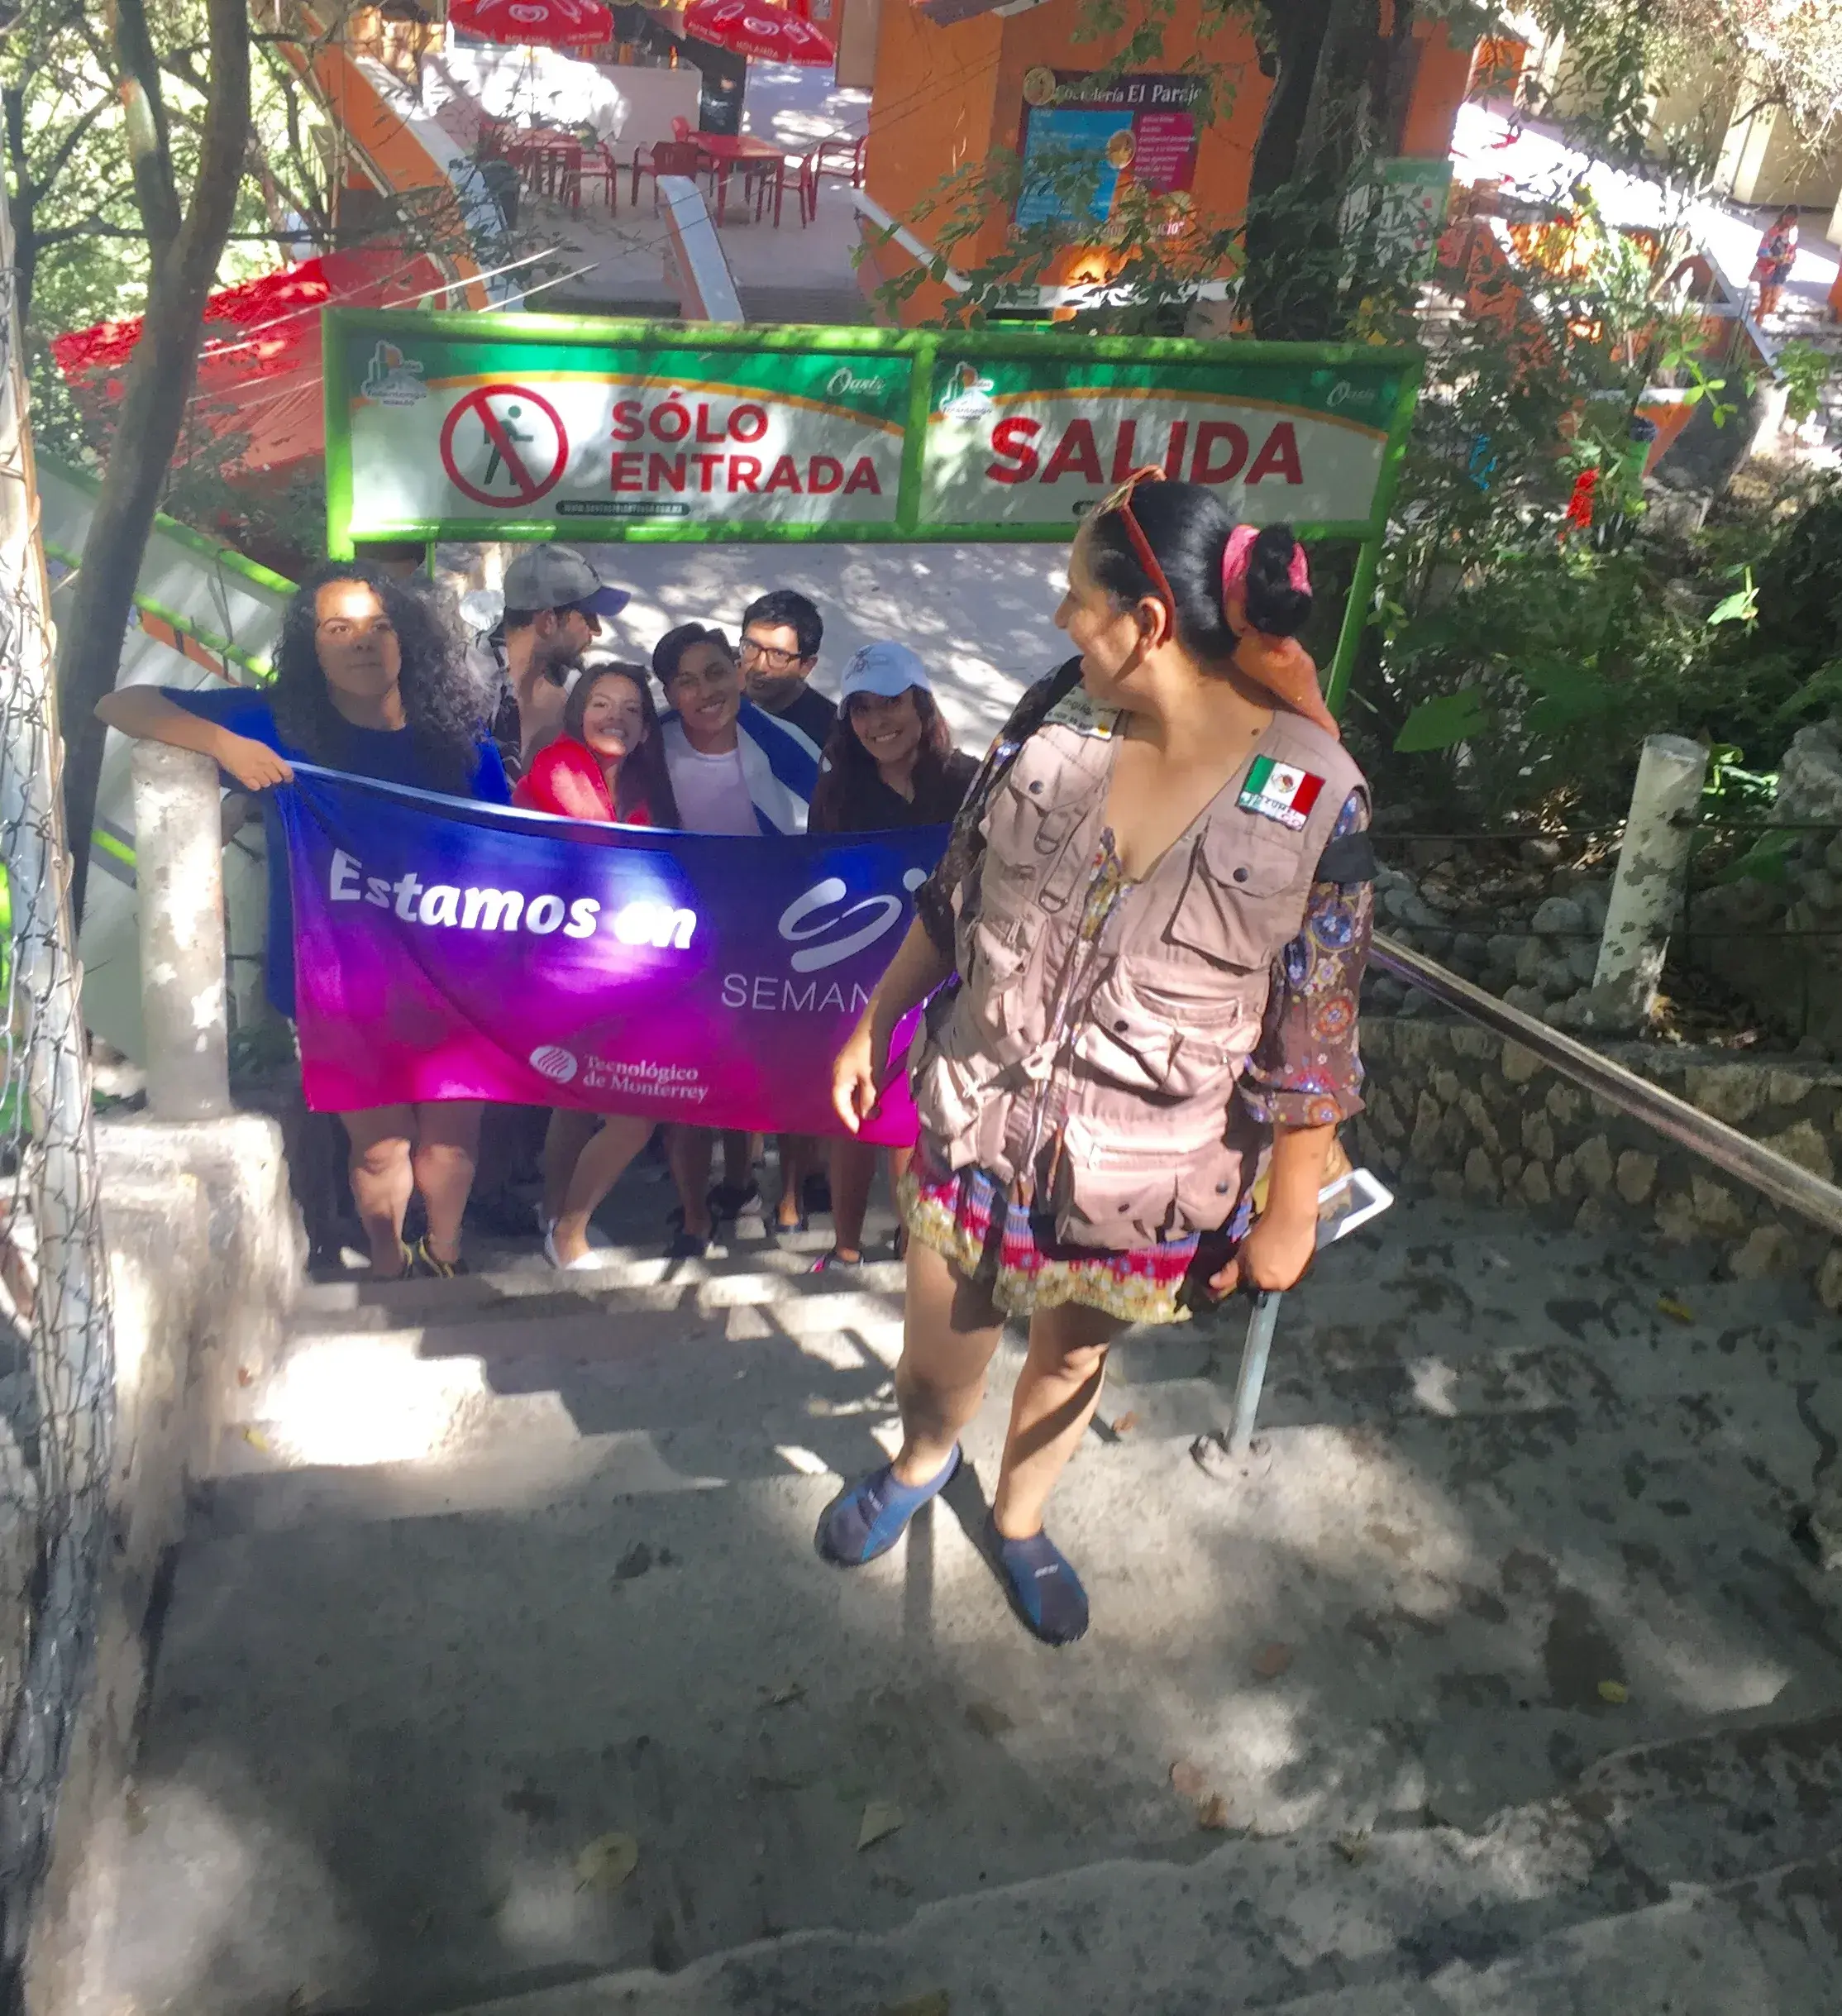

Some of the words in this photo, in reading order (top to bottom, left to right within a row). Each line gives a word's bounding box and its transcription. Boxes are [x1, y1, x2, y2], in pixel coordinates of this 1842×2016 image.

[736, 41, 780, 60] HOLANDA
[1127, 84, 1145, 103] El
[610, 390, 769, 444] SÓLO
[985, 416, 1304, 485] SALIDA
[610, 451, 882, 495] ENTRADA
[330, 848, 601, 939] Estamos
[614, 901, 698, 950] en
[583, 1054, 699, 1083] Tecnológico
[583, 1070, 605, 1087] de
[610, 1074, 709, 1104] Monterrey
